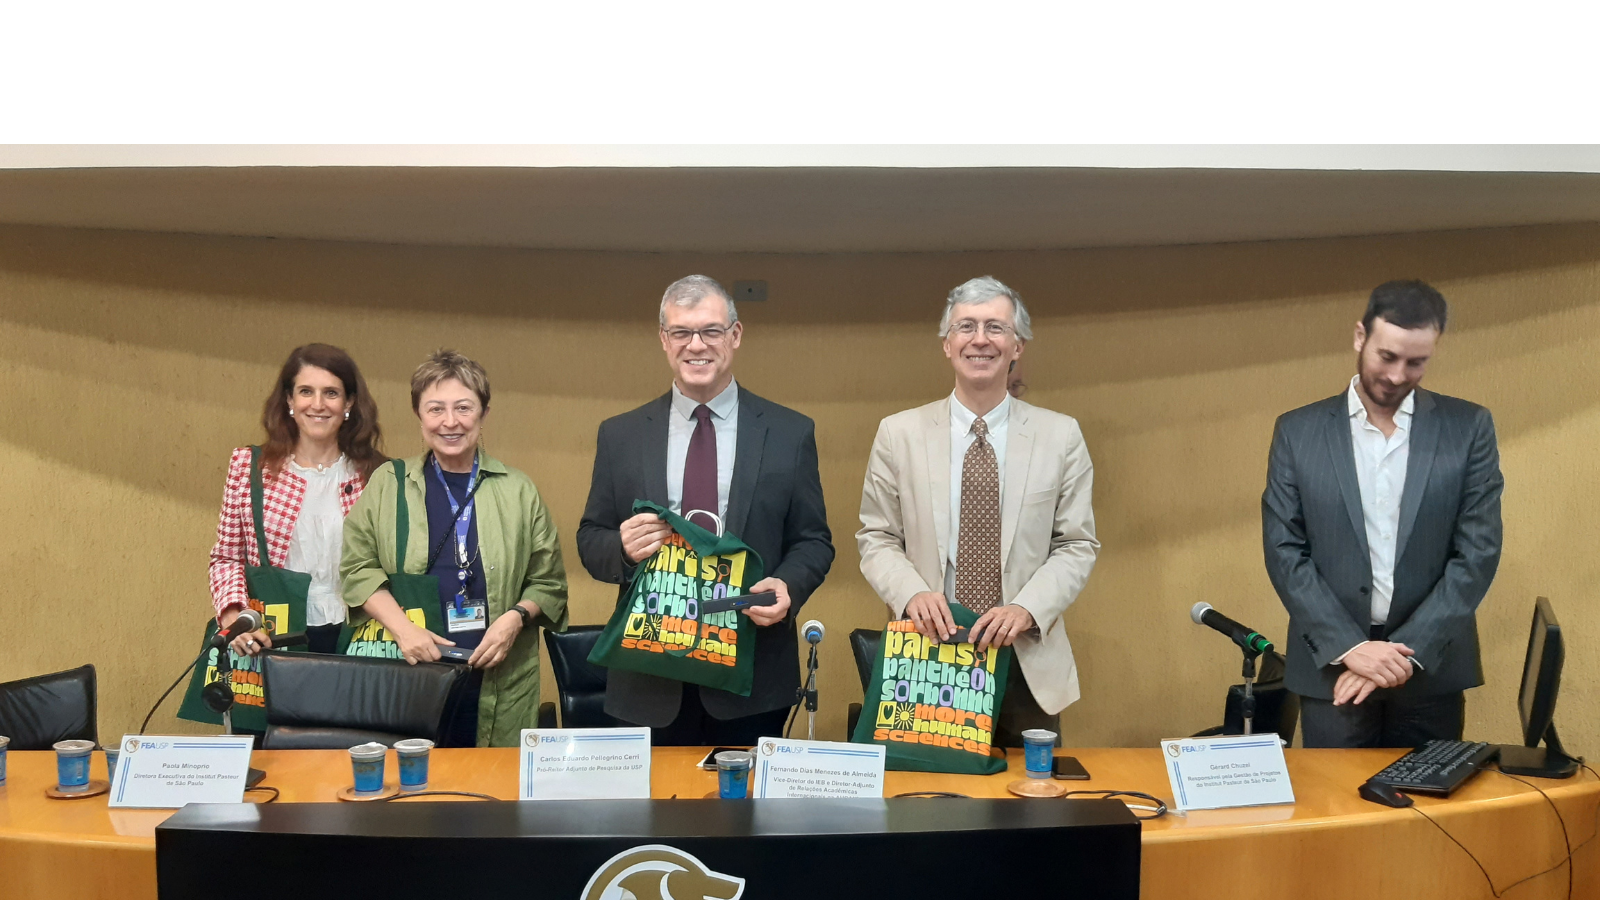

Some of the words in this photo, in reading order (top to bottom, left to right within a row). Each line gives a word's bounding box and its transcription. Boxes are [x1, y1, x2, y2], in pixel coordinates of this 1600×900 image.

[661, 615, 737, 644] more
[346, 641, 404, 660] panth
[231, 682, 264, 697] hum
[883, 658, 996, 695] panthéon
[881, 680, 994, 716] sorbonne
[914, 703, 993, 732] more
[873, 729, 991, 757] sciences
[912, 719, 992, 745] human
